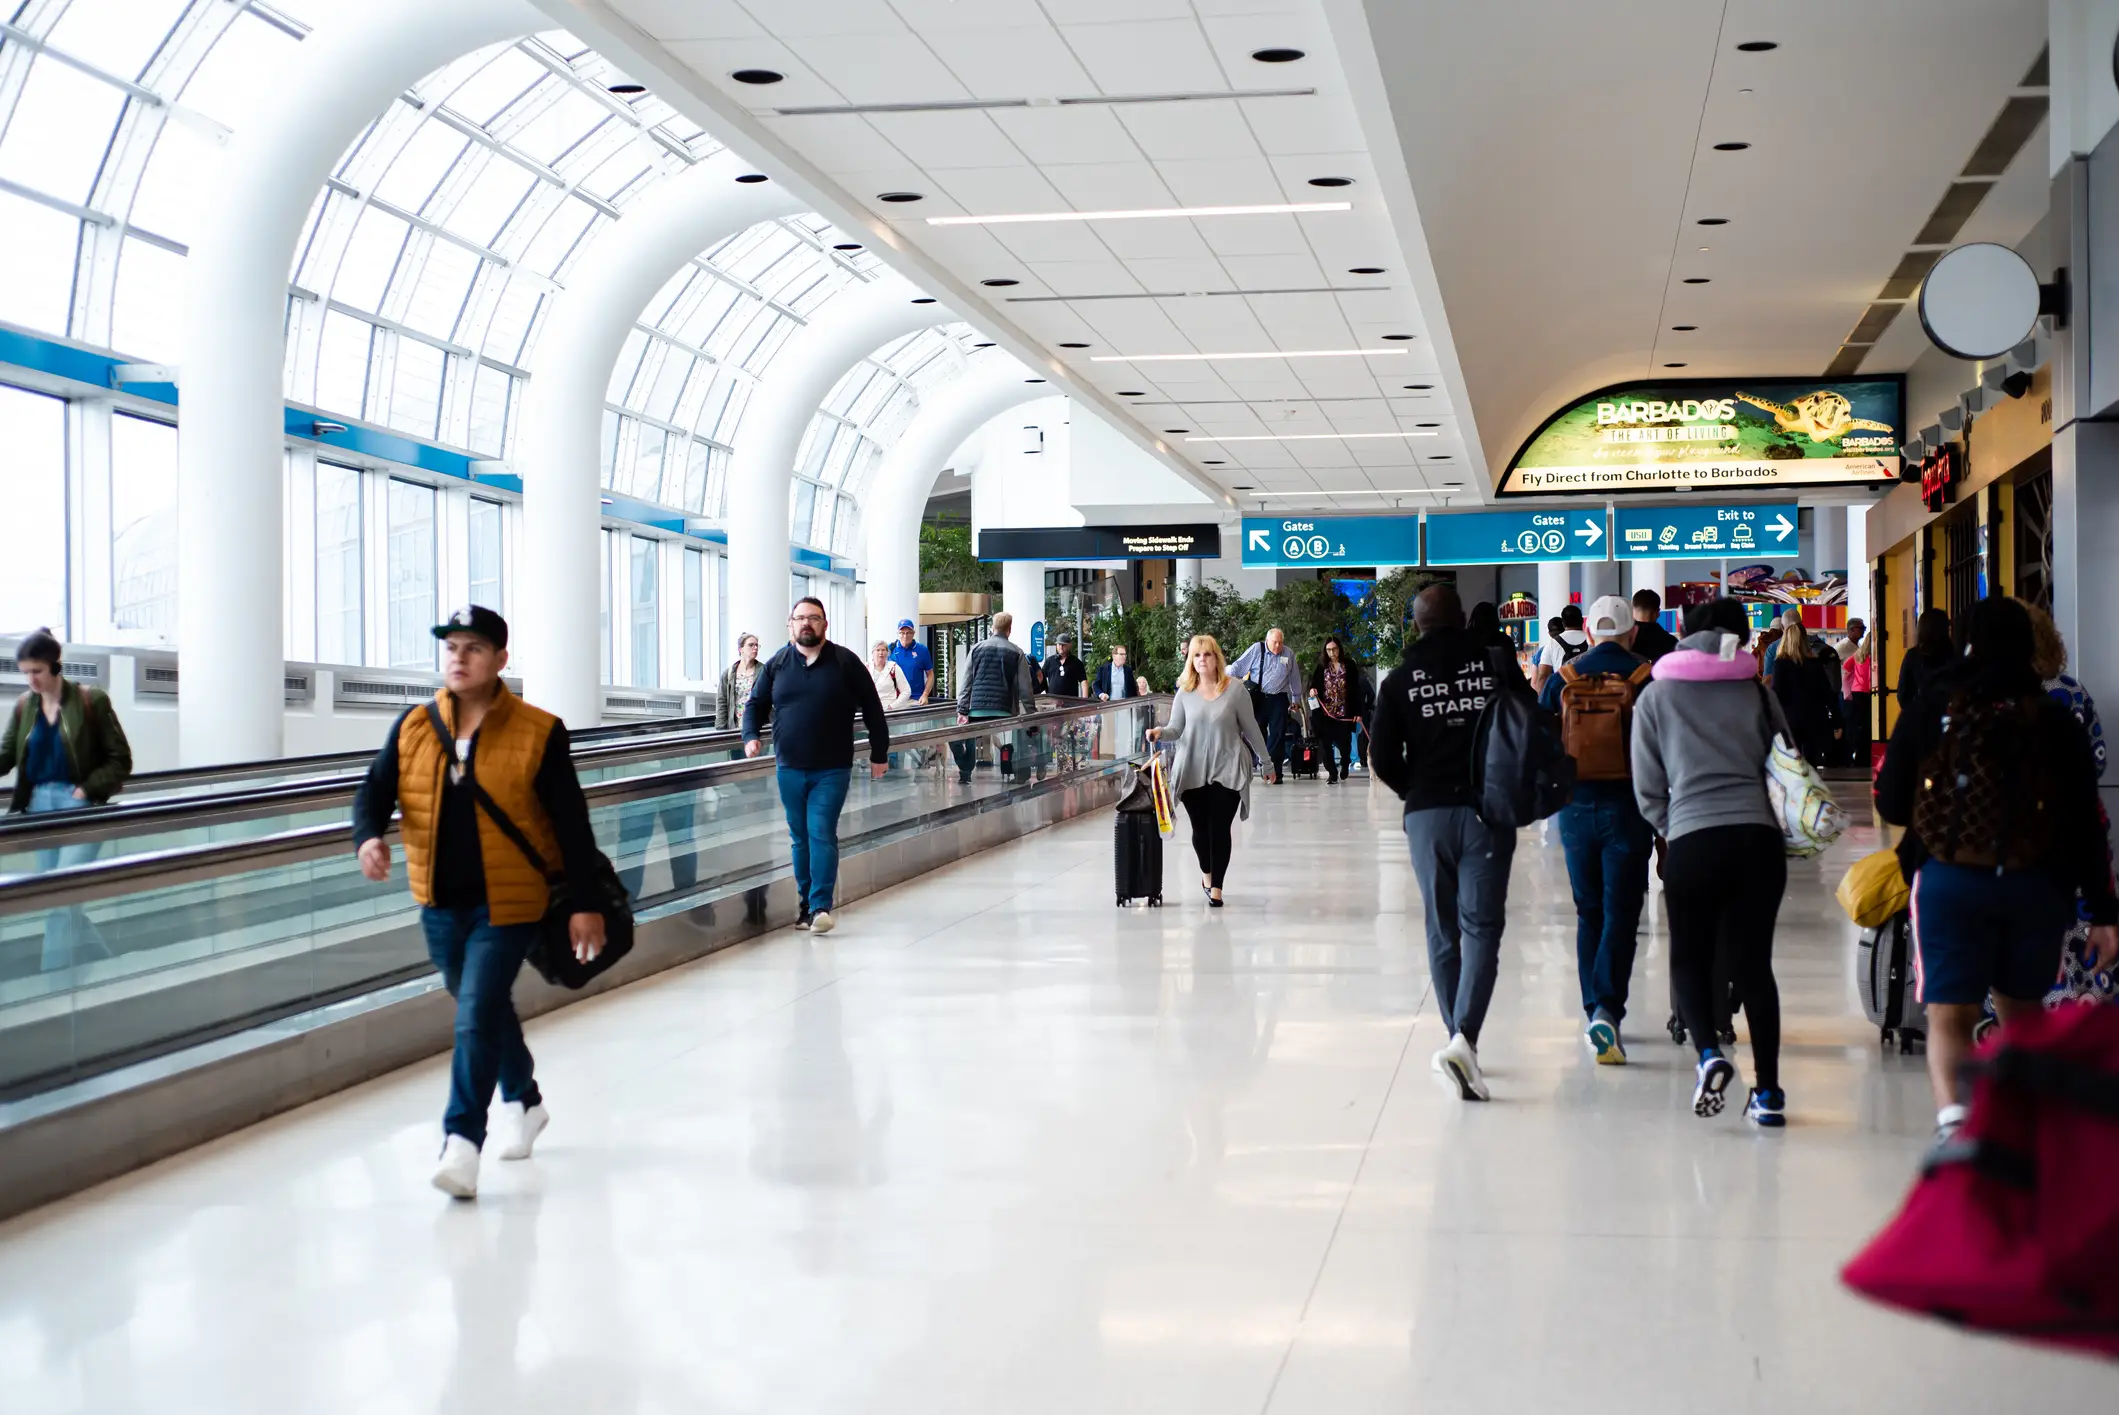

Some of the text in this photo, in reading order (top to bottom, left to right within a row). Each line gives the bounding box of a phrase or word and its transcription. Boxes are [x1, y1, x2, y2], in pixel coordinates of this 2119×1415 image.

[1597, 399, 1736, 425] BARBADOS
[1611, 427, 1727, 441] THE ART OF LIVING
[1842, 437, 1894, 447] BARBADOS
[1522, 466, 1778, 486] Fly Direct from Charlotte to Barbados
[1532, 515, 1564, 525] Gates
[1718, 510, 1755, 520] Exit to
[1283, 521, 1314, 531] Gates
[1123, 537, 1147, 545] Moving
[1289, 540, 1323, 552] A B
[1525, 534, 1559, 547] E D
[1128, 545, 1154, 553] Prepare
[1162, 544, 1177, 552] Step
[1499, 601, 1515, 619] PAPA
[1408, 677, 1494, 702] FOR THE
[1421, 696, 1486, 718] STARS
